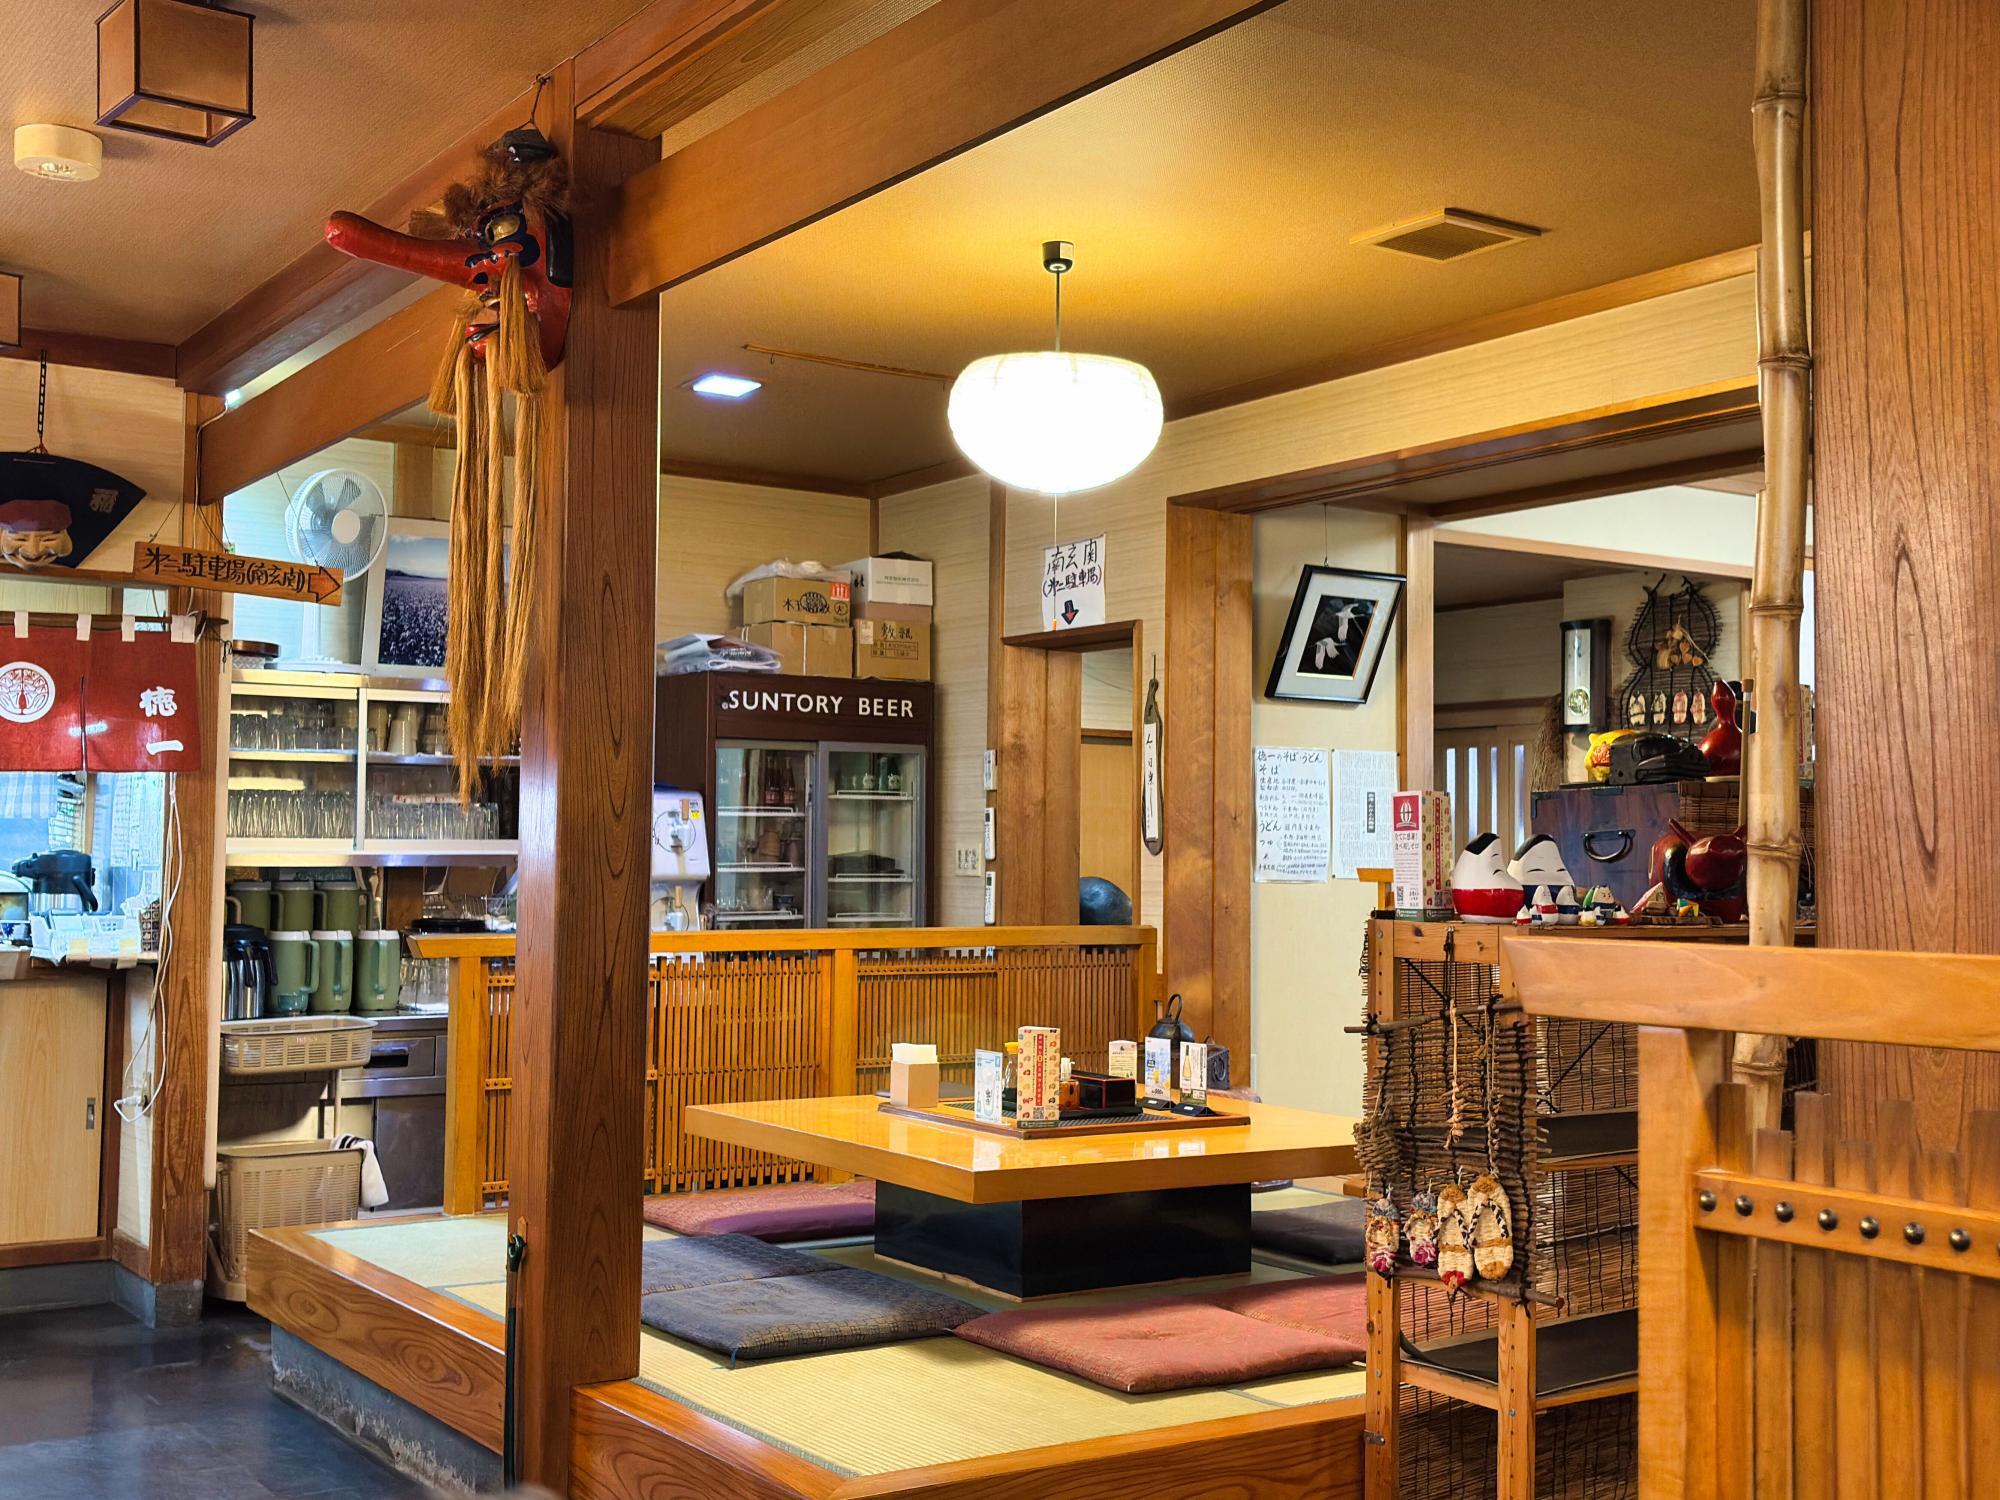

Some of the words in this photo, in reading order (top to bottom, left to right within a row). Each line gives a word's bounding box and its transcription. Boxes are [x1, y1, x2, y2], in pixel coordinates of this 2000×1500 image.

[1047, 538, 1098, 575] 南玄関
[728, 690, 843, 715] SUNTORY
[858, 697, 914, 718] BEER
